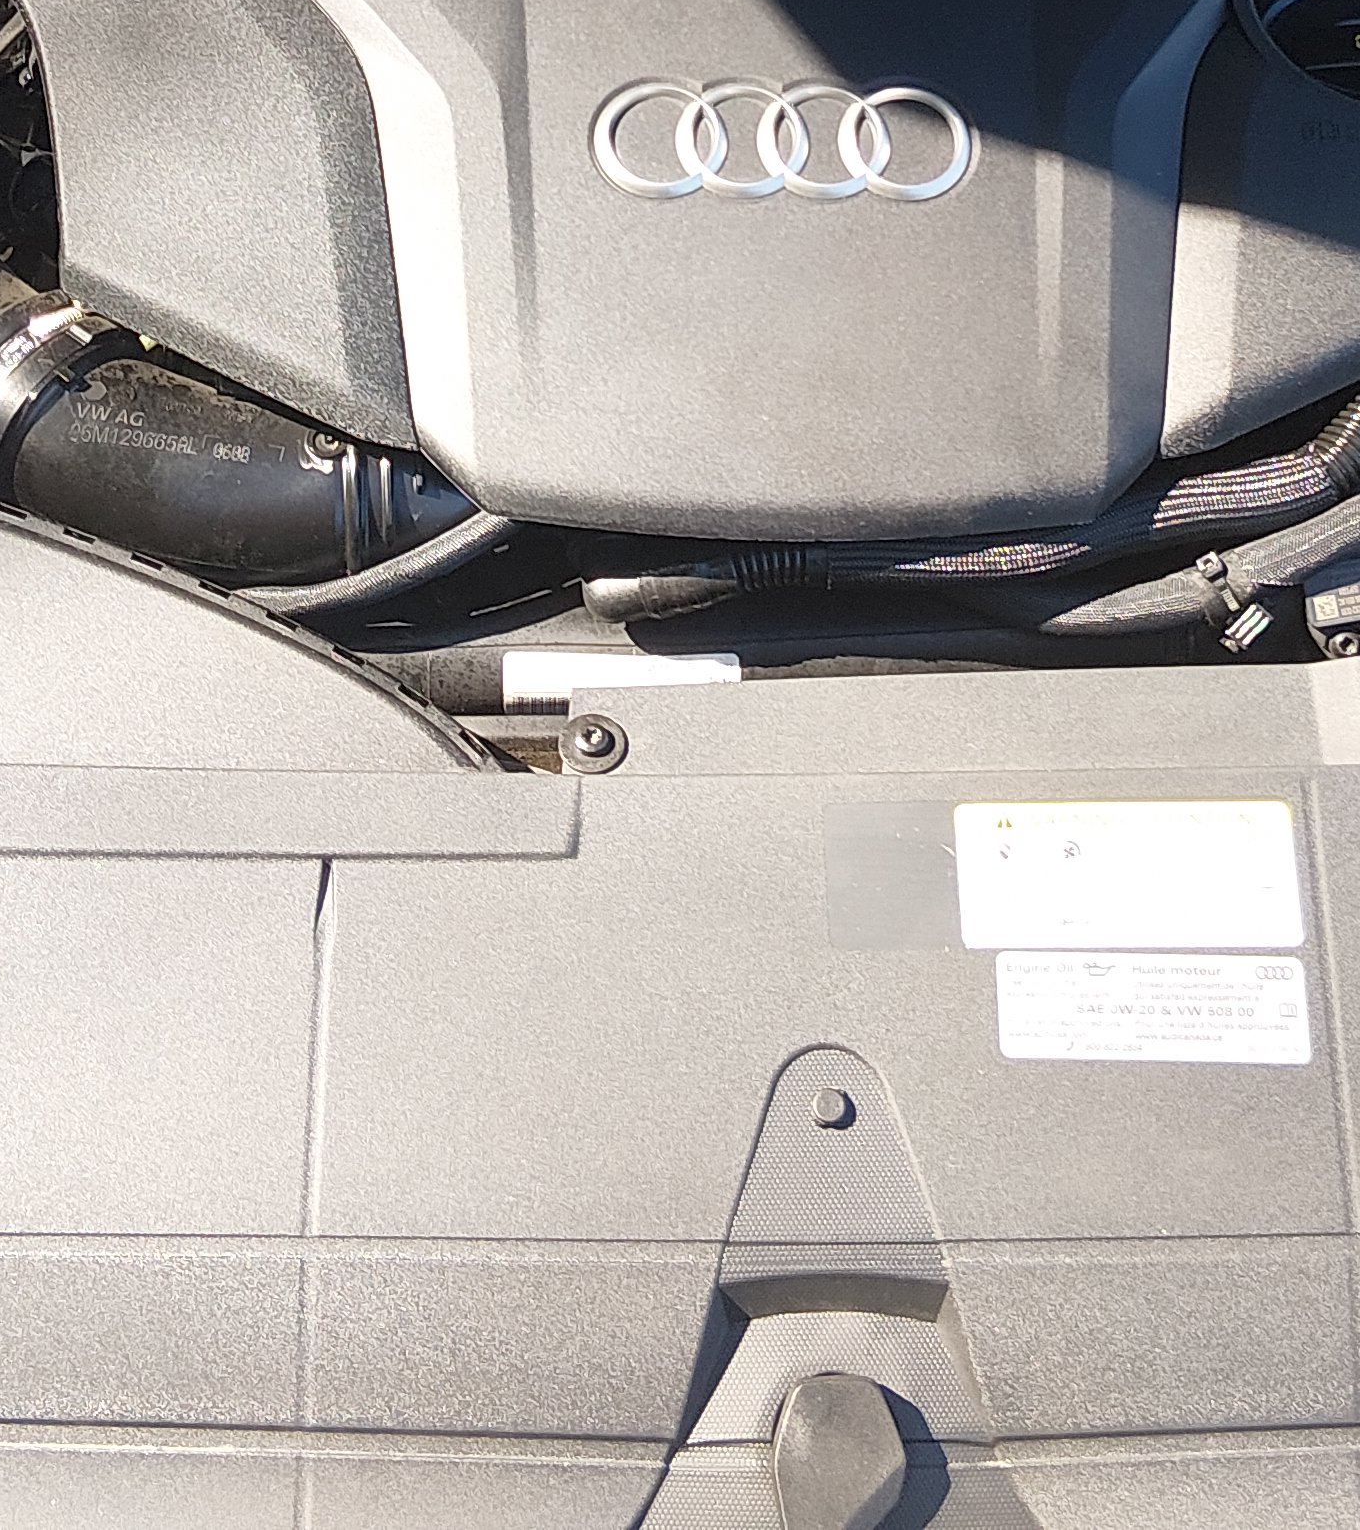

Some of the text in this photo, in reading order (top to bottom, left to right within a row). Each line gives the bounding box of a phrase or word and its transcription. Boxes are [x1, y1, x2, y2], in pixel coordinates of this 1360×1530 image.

[73, 402, 112, 425] VW
[116, 410, 145, 427] AG
[1132, 965, 1222, 976] Huile moteur
[1076, 1004, 1255, 1017] SAE 0W-20 & VW 508 00
